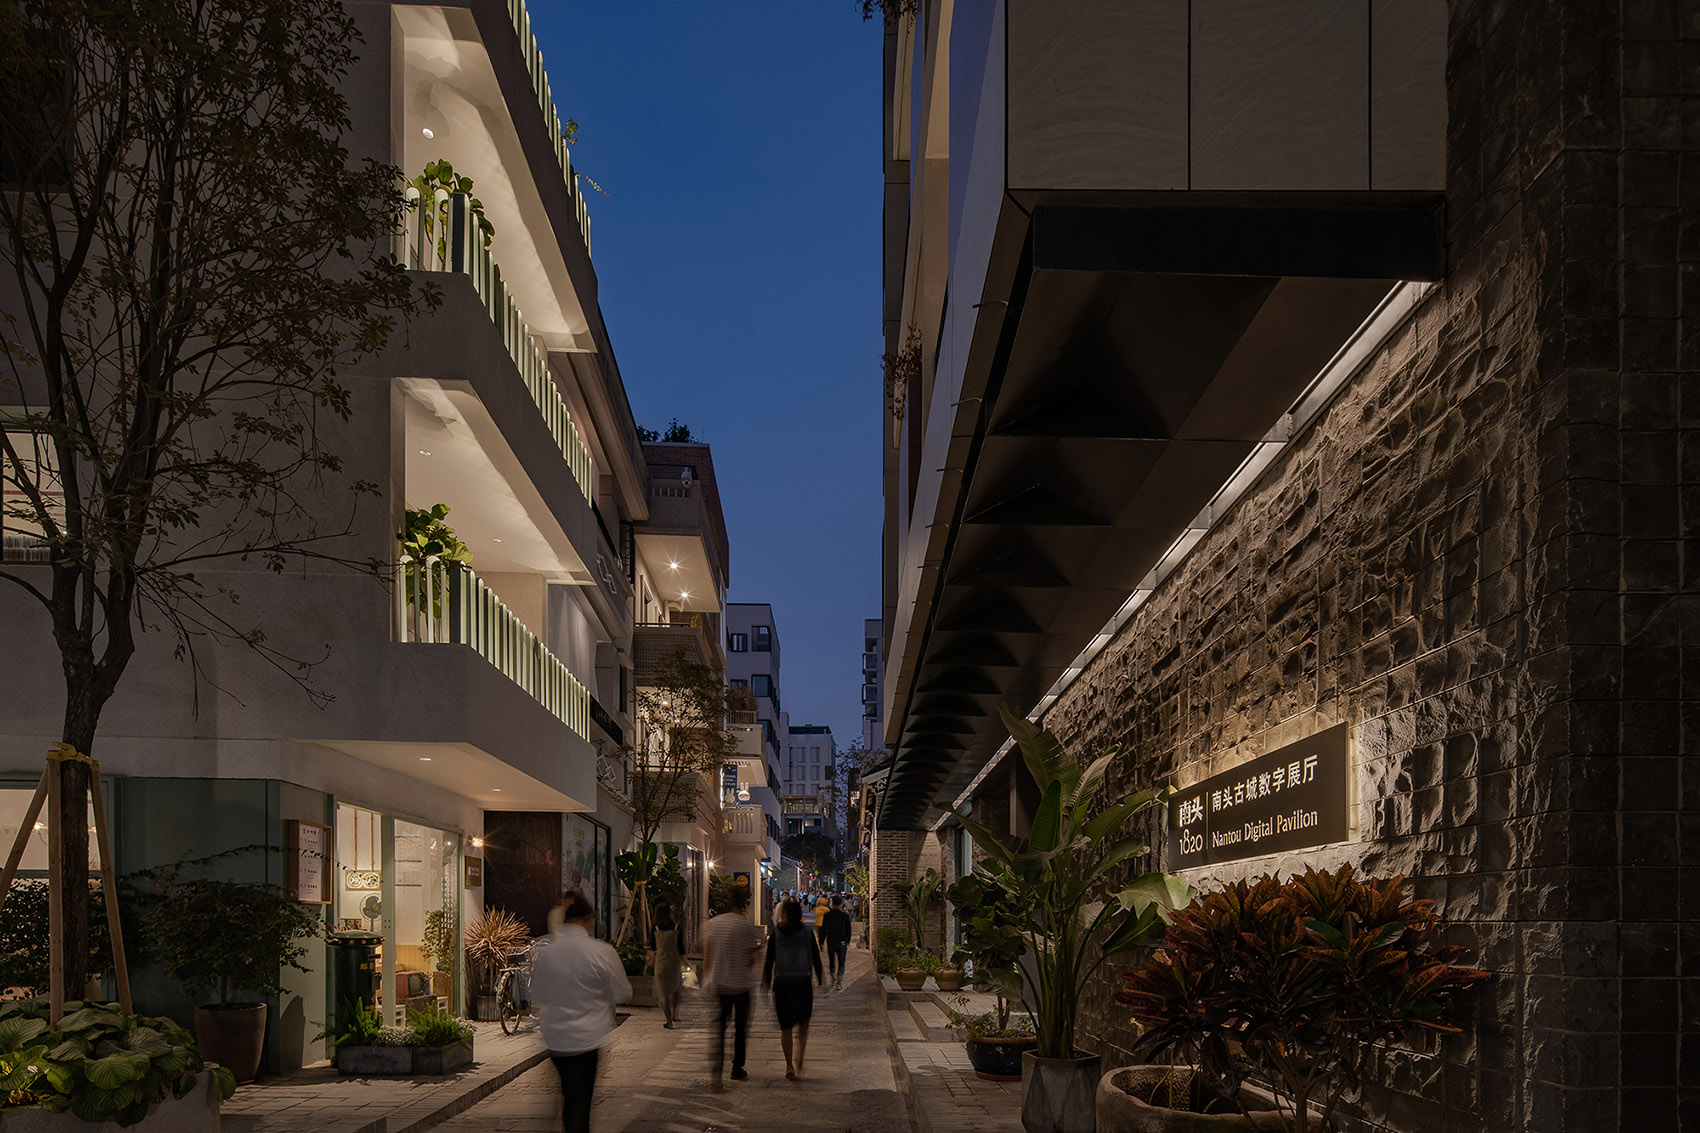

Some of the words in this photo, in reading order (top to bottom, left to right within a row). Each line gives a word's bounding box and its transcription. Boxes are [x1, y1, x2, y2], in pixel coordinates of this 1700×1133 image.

[1212, 754, 1318, 813] 南头古城数字展厅
[1179, 795, 1203, 828] 南头
[1212, 829, 1242, 848] Nantou
[1244, 816, 1274, 842] Digital
[1276, 808, 1318, 834] Pavilion
[1179, 829, 1203, 855] 1820
